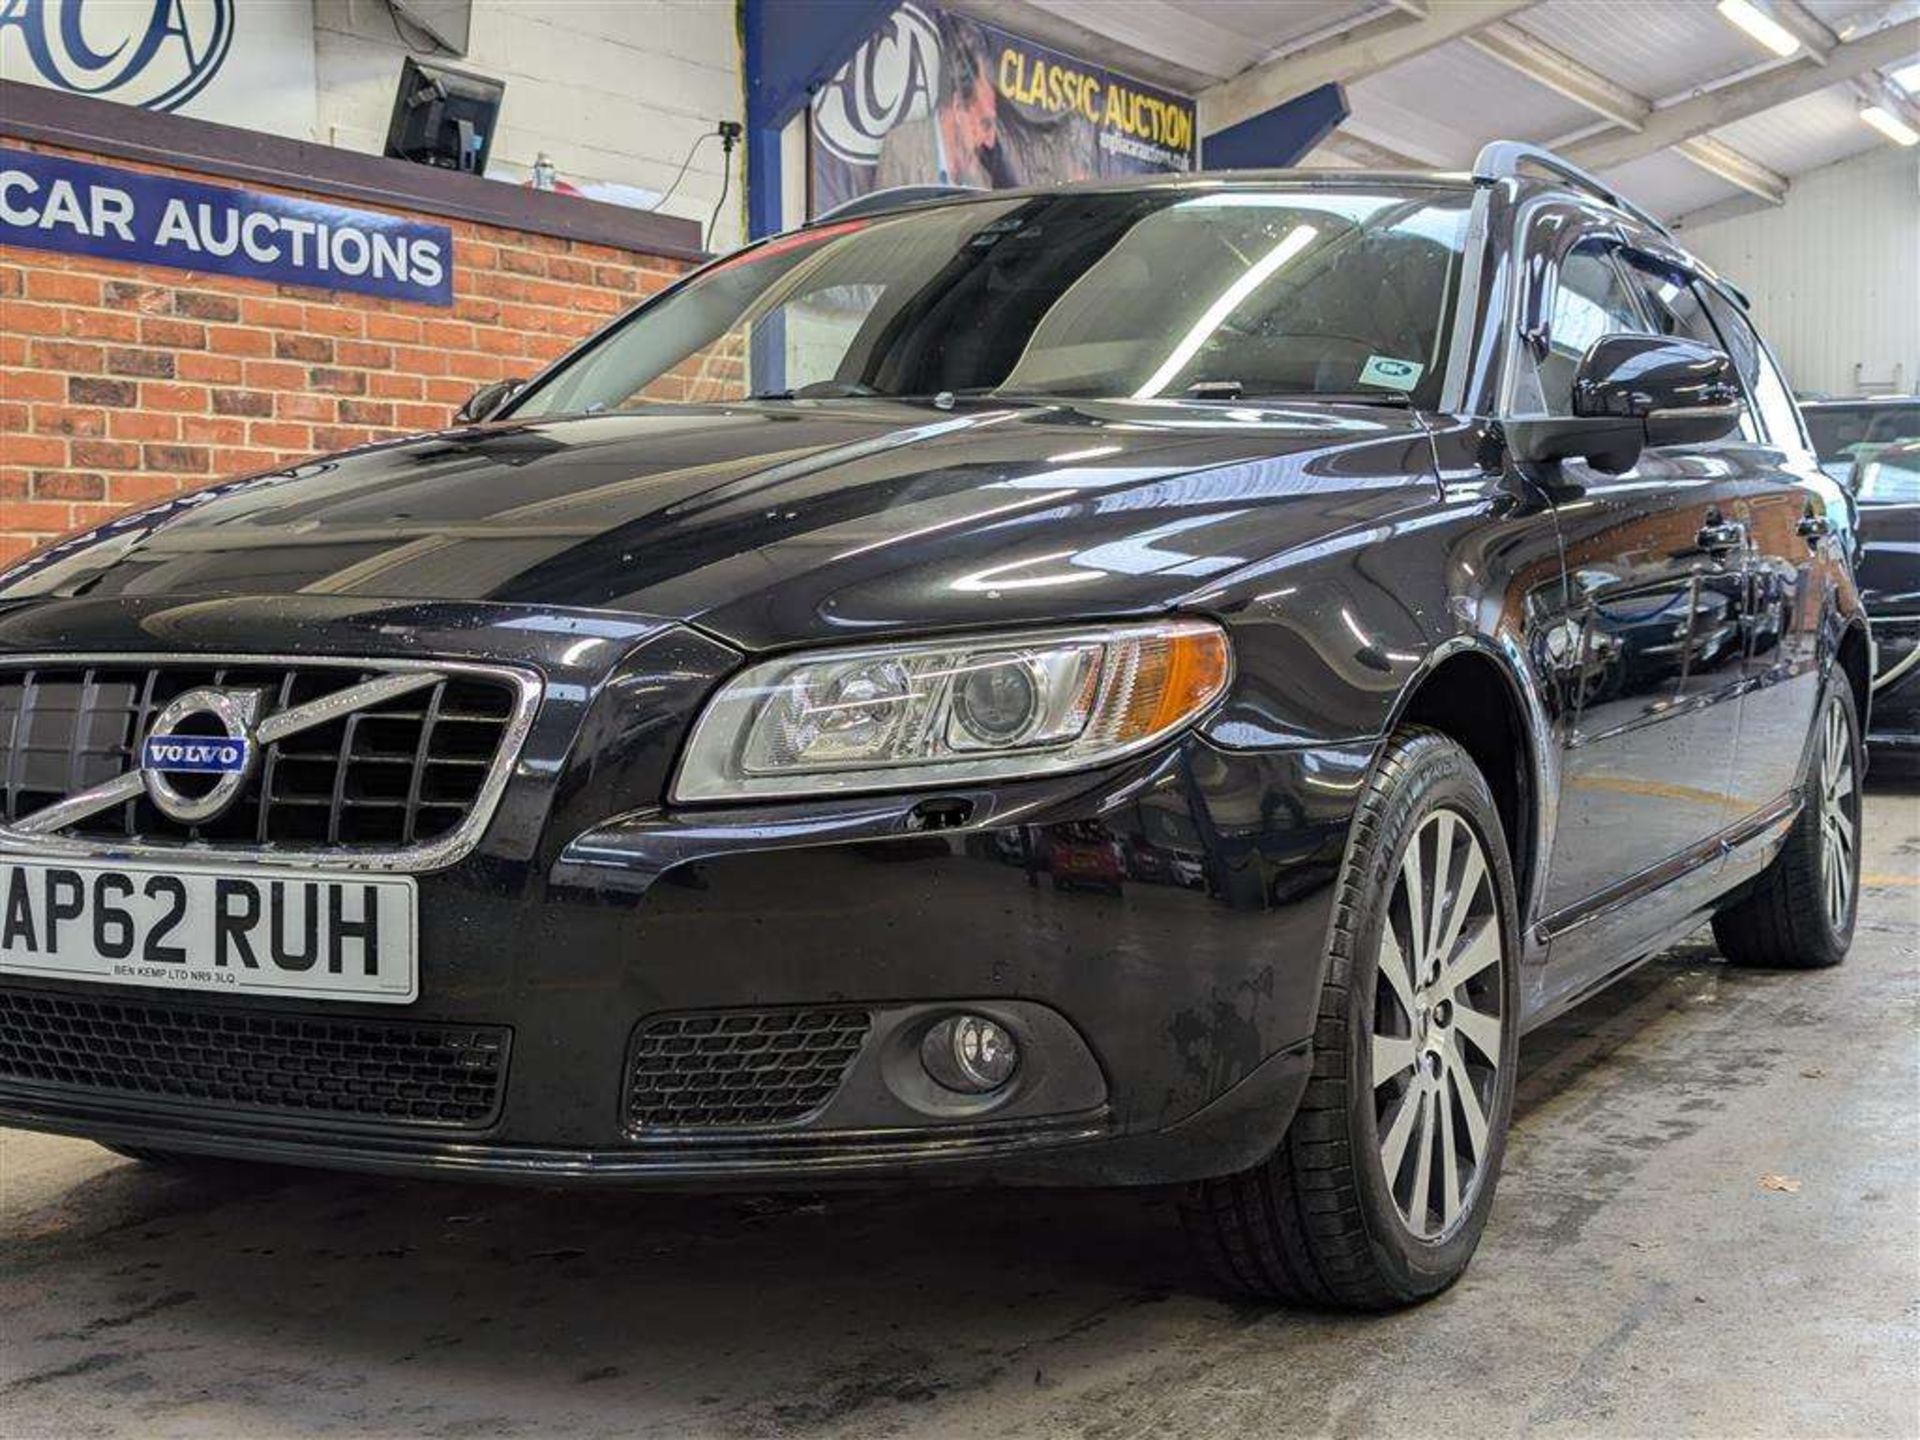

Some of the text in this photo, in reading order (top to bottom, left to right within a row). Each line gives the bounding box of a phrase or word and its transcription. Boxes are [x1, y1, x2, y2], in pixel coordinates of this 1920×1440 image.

[1000, 48, 1192, 151] CLASSIC AUCTION
[0, 170, 443, 287] CAR AUCTIONS
[150, 745, 238, 764] VOLVO
[2, 867, 379, 976] AP62 RUH
[114, 965, 135, 976] BEN
[139, 966, 167, 978] KEMP
[168, 968, 188, 980] LTD
